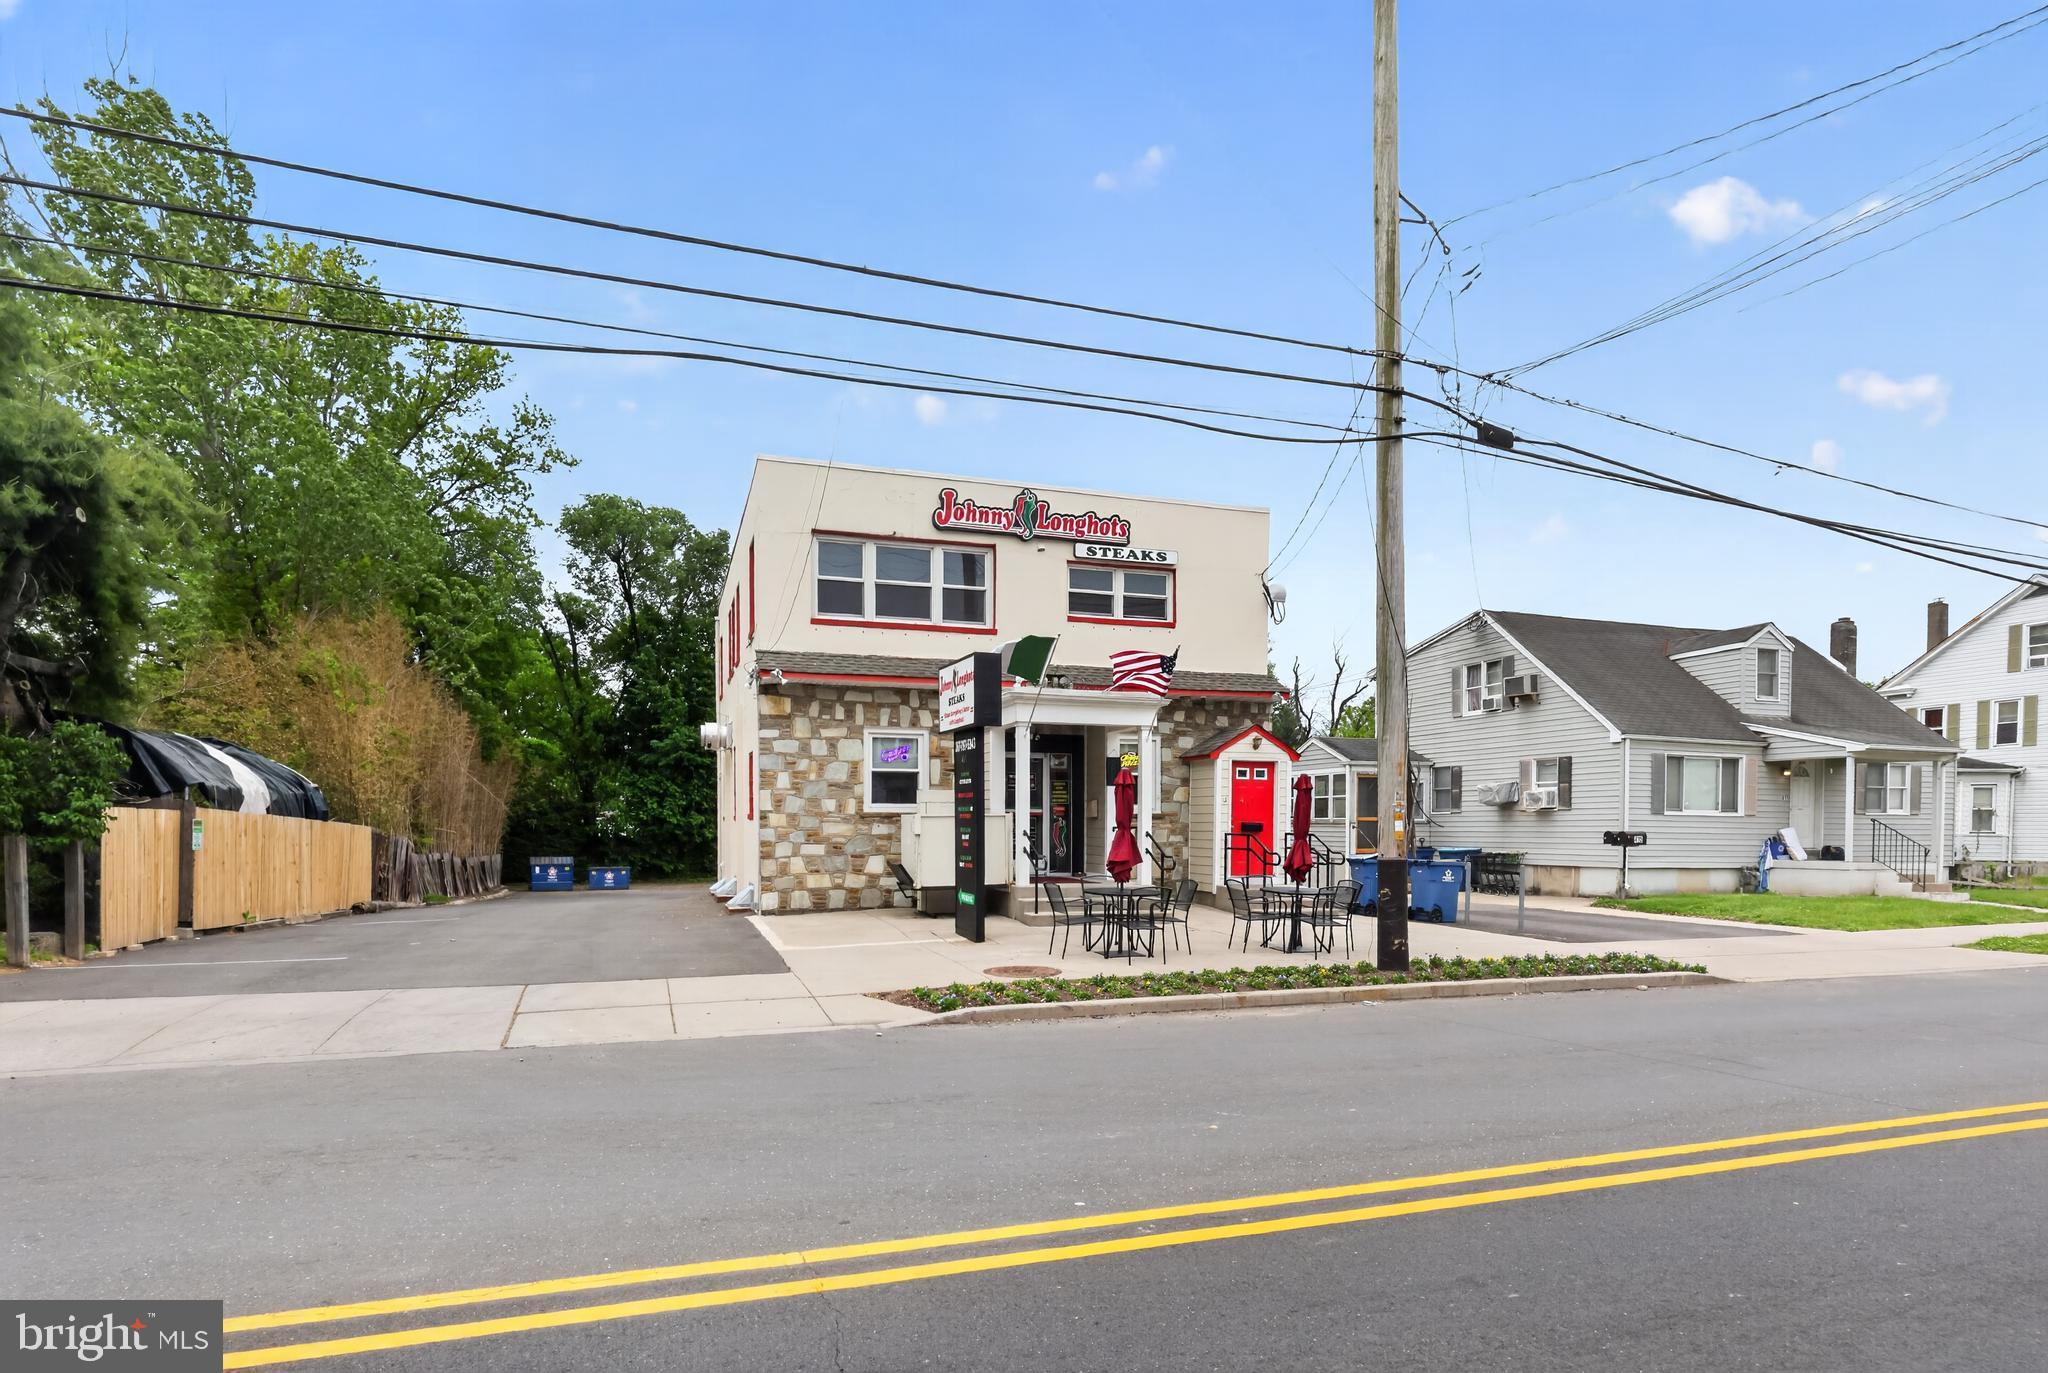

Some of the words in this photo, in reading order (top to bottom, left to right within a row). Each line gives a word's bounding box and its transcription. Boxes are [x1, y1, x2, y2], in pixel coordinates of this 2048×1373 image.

[936, 489, 1015, 531] Johnny
[1036, 501, 1129, 538] Longhots
[1086, 545, 1168, 562] STEAKS
[948, 692, 965, 707] STEAKS
